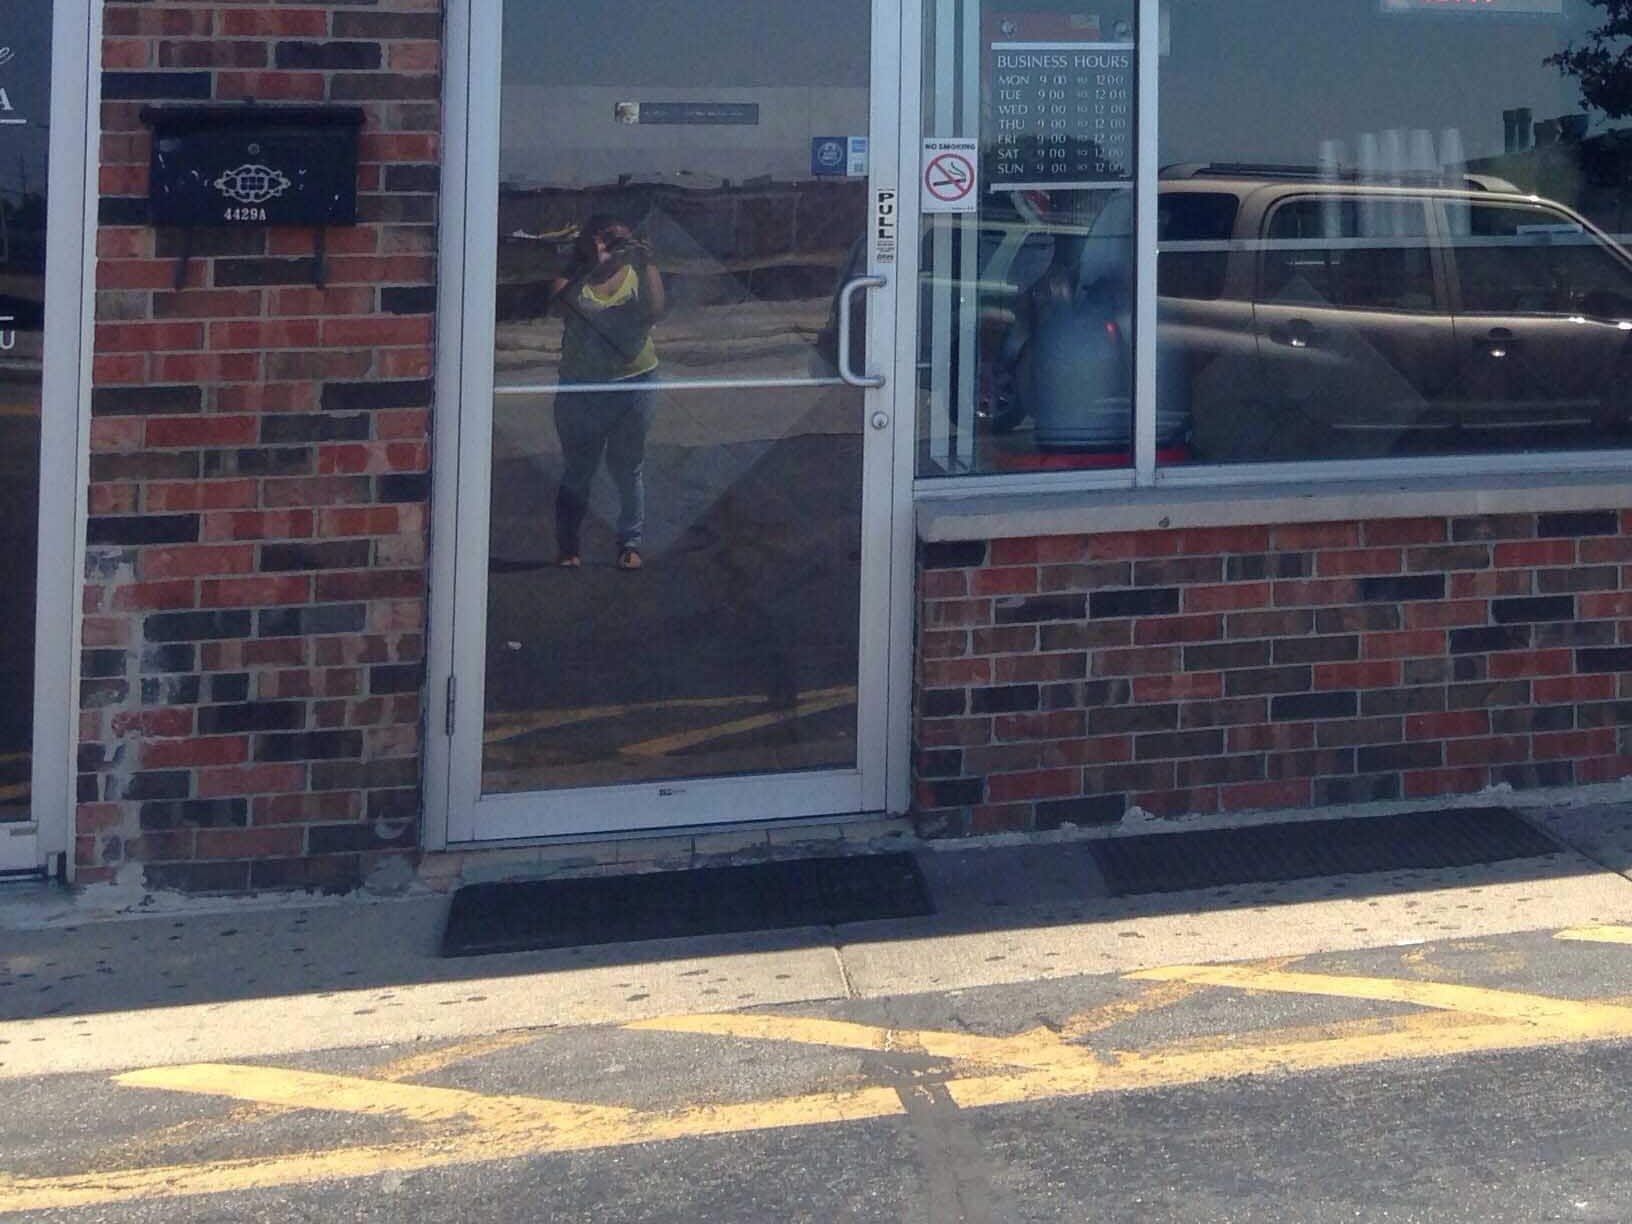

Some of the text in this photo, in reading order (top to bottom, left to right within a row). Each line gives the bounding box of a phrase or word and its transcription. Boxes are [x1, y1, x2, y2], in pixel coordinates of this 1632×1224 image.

[997, 55, 1129, 69] BUSINESS HOURS
[999, 75, 1030, 86] MON
[1000, 89, 1023, 100] TUE
[999, 104, 1028, 115] WED
[999, 119, 1025, 130] THU
[998, 134, 1017, 145] FRI
[997, 148, 1019, 160] SAT
[997, 163, 1024, 174] SUN
[224, 207, 267, 221] 4429A
[878, 192, 894, 239] PULL
